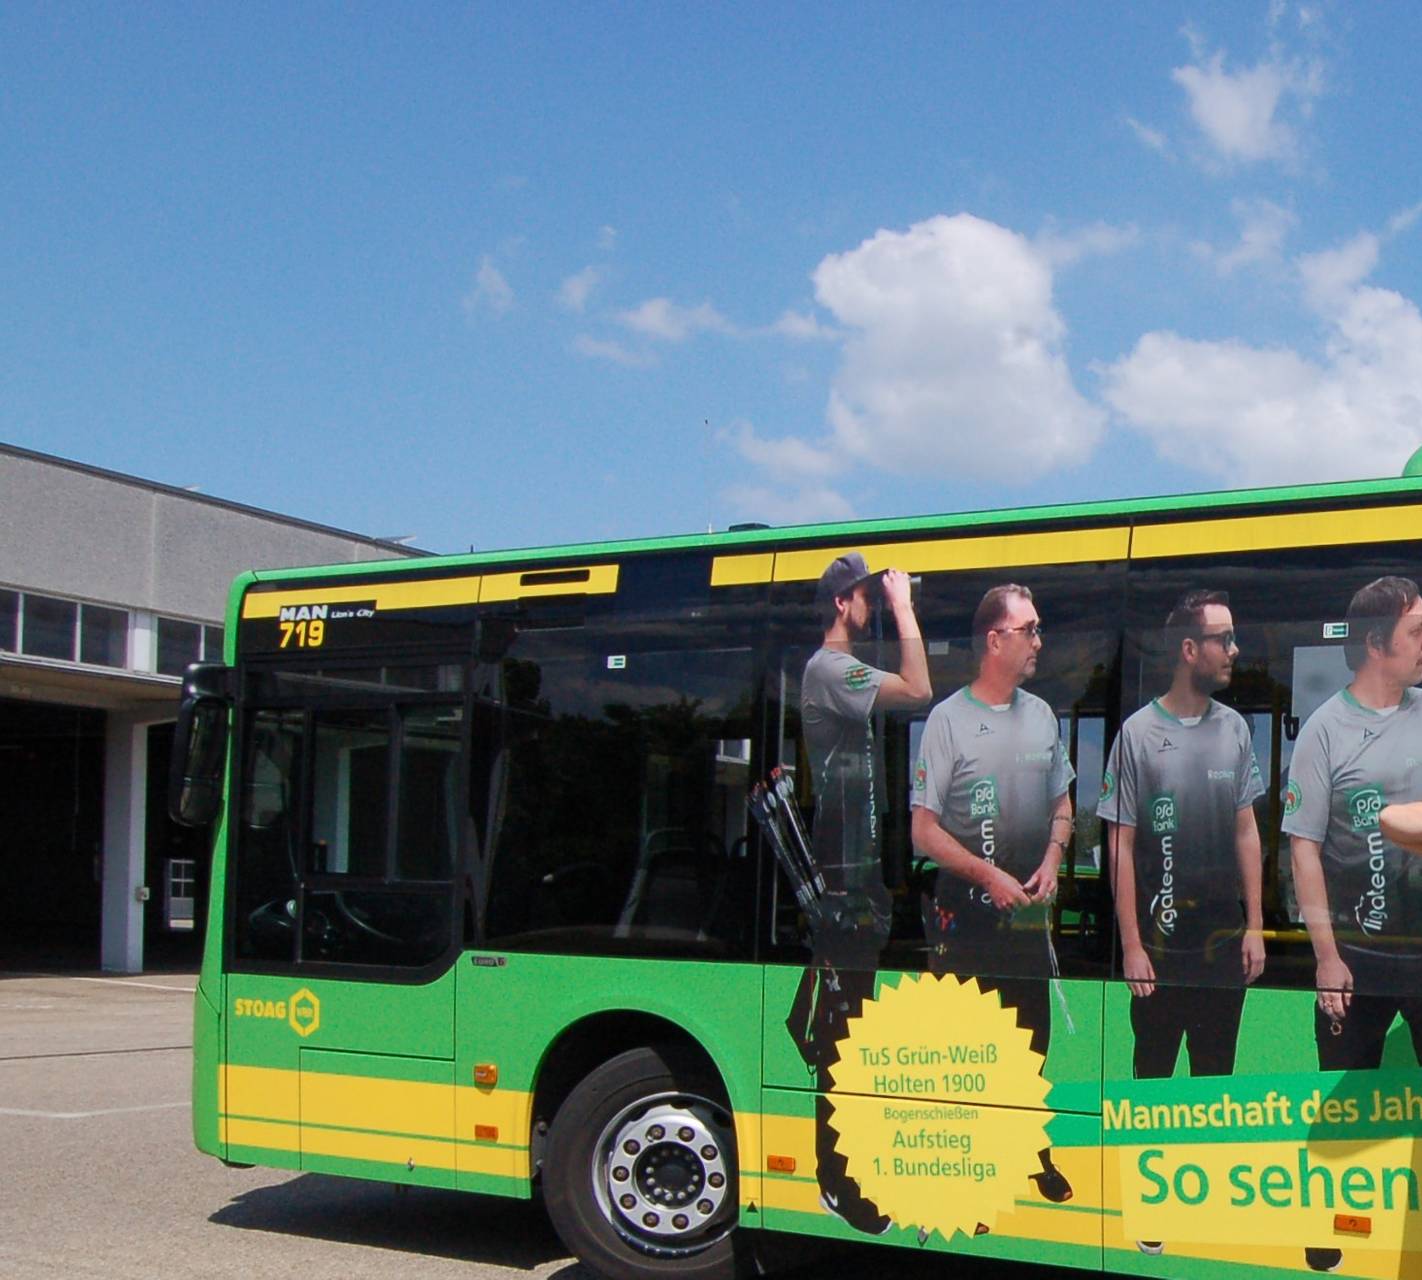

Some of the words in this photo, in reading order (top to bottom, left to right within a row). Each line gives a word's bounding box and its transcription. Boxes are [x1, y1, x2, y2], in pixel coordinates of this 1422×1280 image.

[280, 605, 328, 621] MAN
[280, 620, 325, 648] 719
[1161, 835, 1178, 932] igateam
[235, 998, 286, 1019] STOAG
[859, 1047, 890, 1066] TuS
[896, 1043, 998, 1065] Grün-Weiß
[874, 1074, 935, 1093] Holten
[942, 1073, 986, 1093] 1900
[884, 1106, 979, 1123] Bogenschießen
[1103, 1091, 1293, 1130] Mannschaft
[1301, 1089, 1359, 1125] des
[892, 1128, 972, 1154] Aufstieg
[873, 1157, 888, 1177] 1.
[893, 1156, 997, 1182] Bundesliga
[1138, 1149, 1209, 1206] So
[1228, 1147, 1420, 1212] sehen
